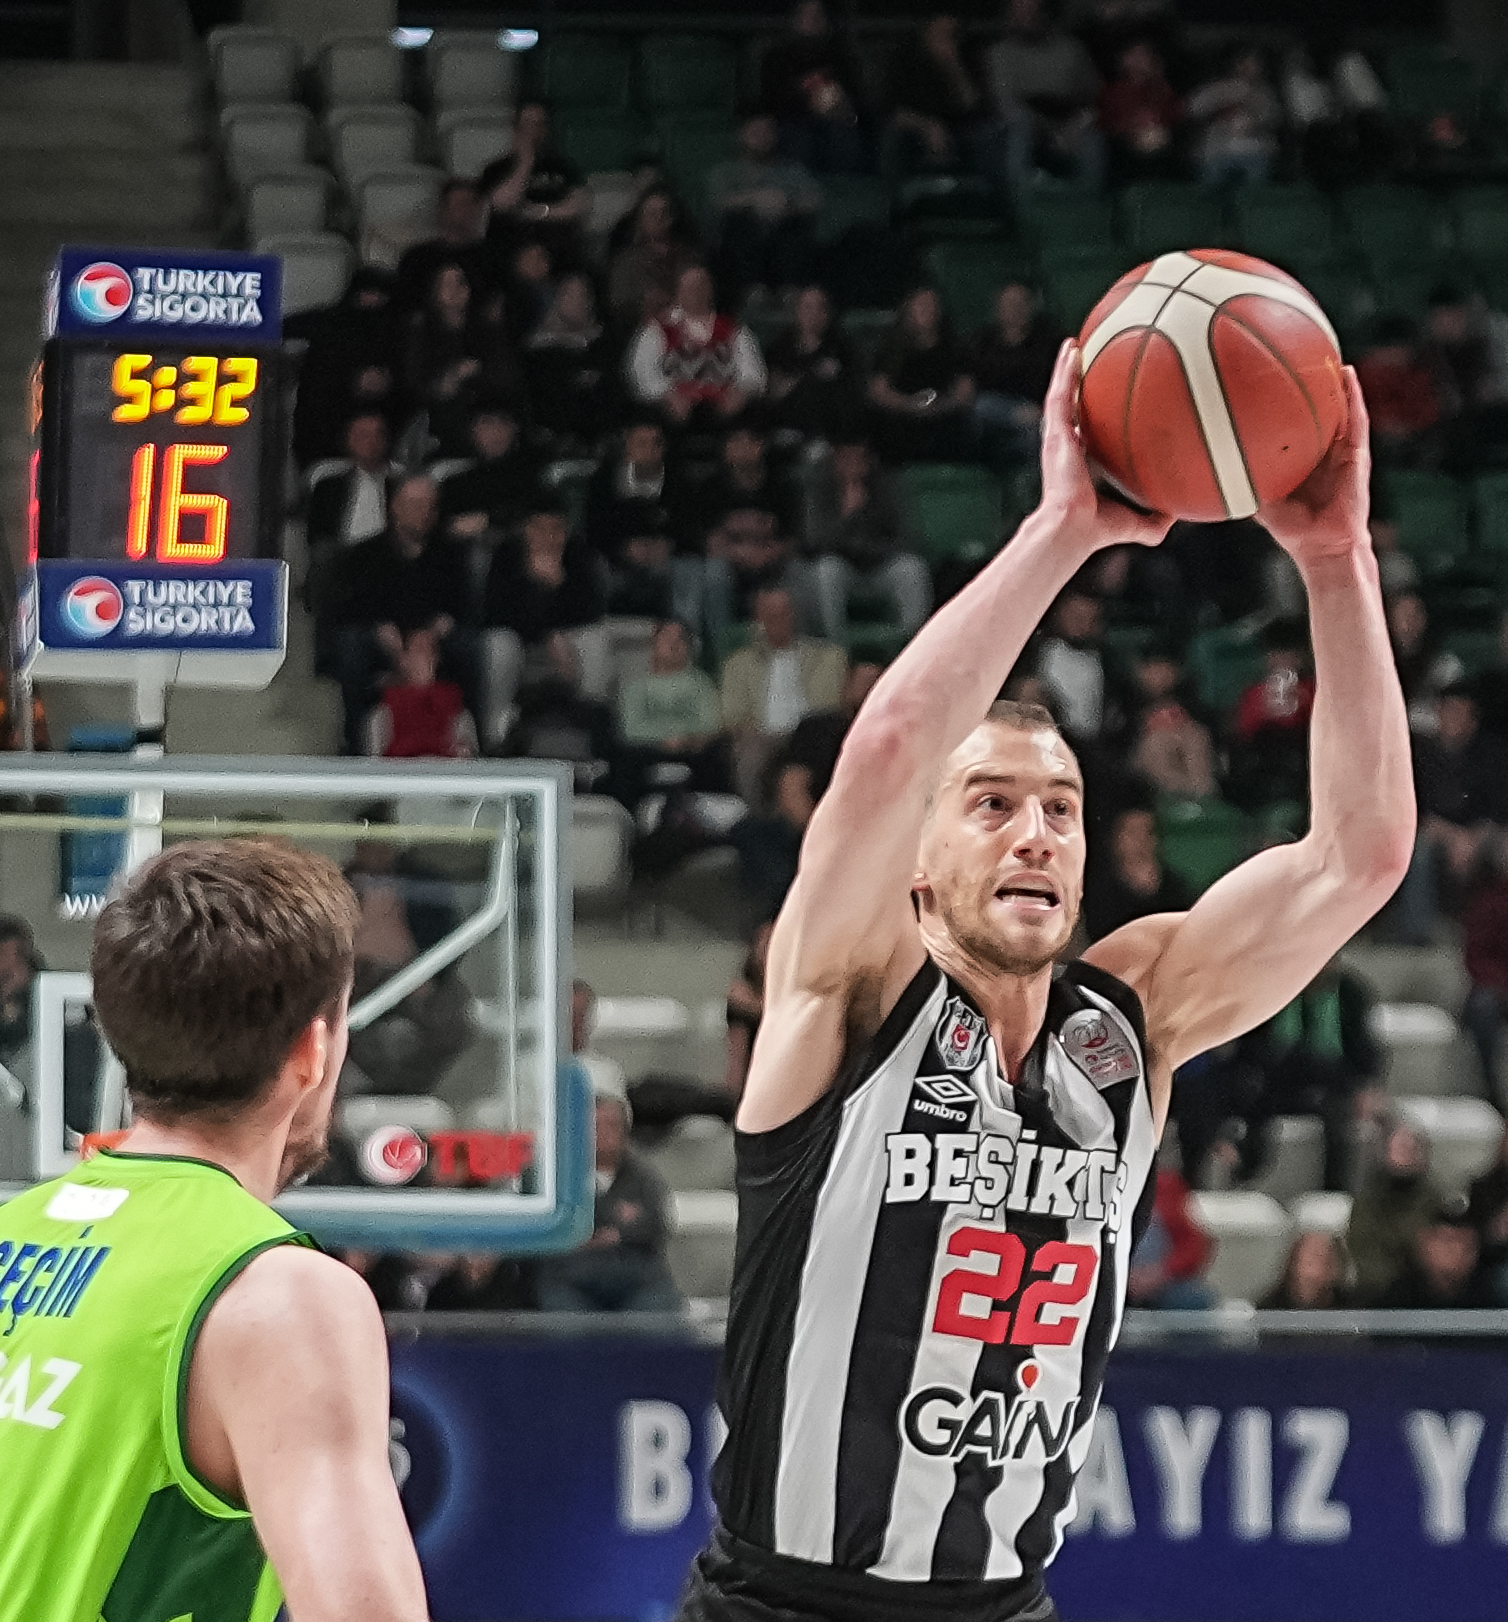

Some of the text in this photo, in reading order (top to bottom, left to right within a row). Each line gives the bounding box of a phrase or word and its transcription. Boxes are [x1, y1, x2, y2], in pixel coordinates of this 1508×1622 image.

[110, 353, 259, 427] 5:32
[126, 442, 230, 564] 16
[913, 1098, 968, 1122] umbro
[932, 1226, 1099, 1346] 22
